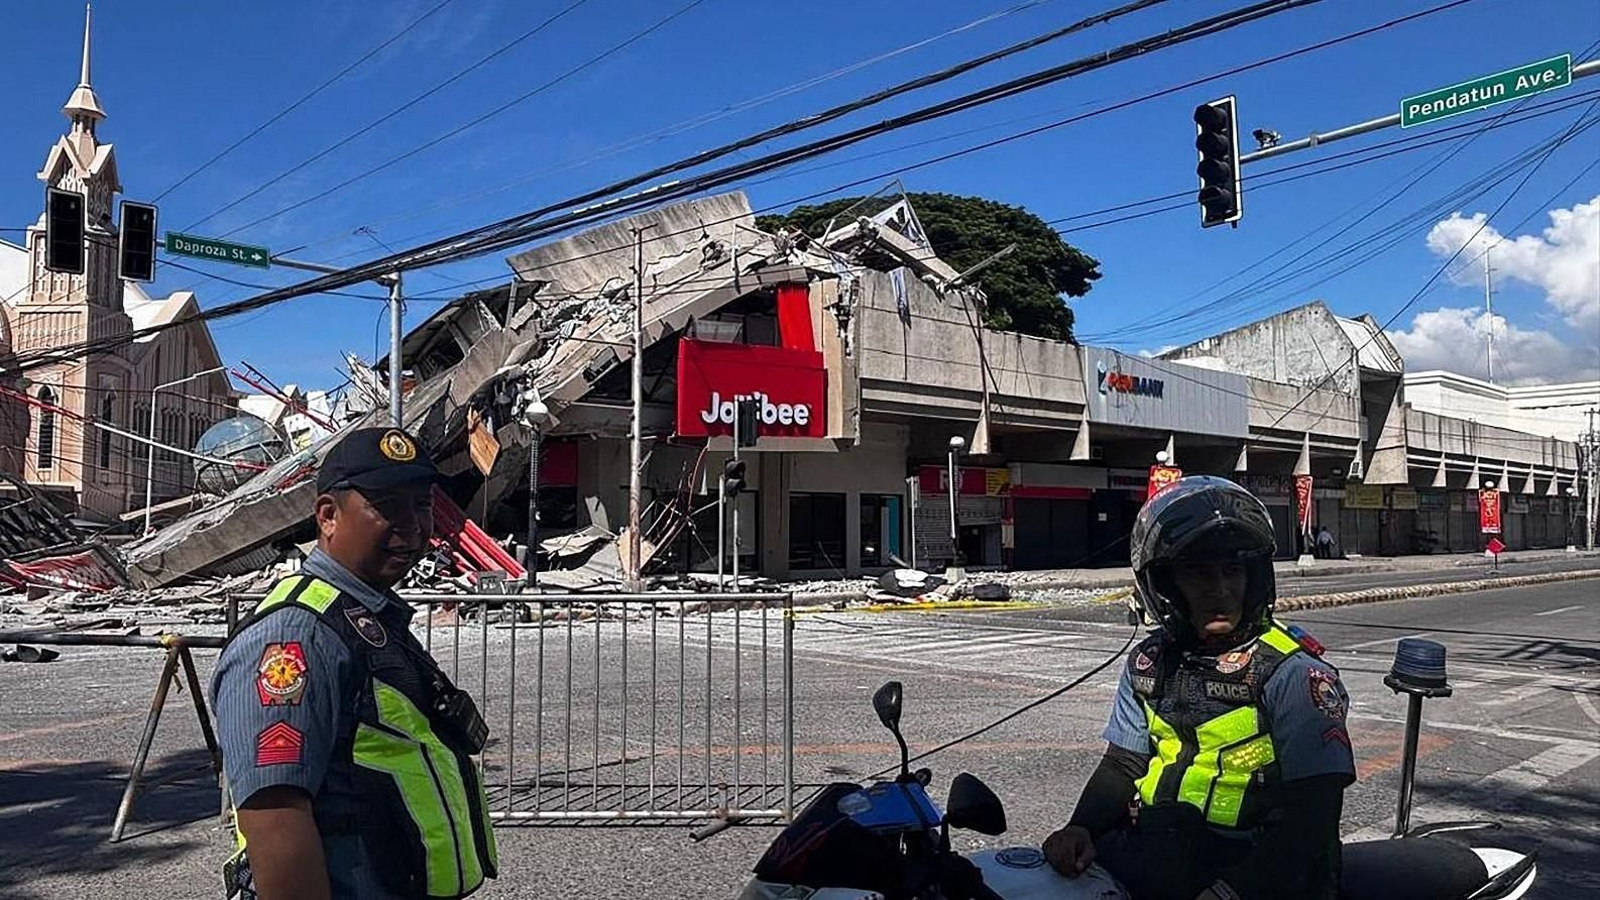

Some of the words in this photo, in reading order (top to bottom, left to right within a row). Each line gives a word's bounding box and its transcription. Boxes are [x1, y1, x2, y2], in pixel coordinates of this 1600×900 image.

[1409, 83, 1505, 119] Pendatun
[1515, 69, 1562, 91] Ave.
[175, 239, 226, 256] Daproza
[232, 248, 247, 260] St.
[701, 391, 809, 425] Joibee
[1206, 681, 1250, 699] POLICE
